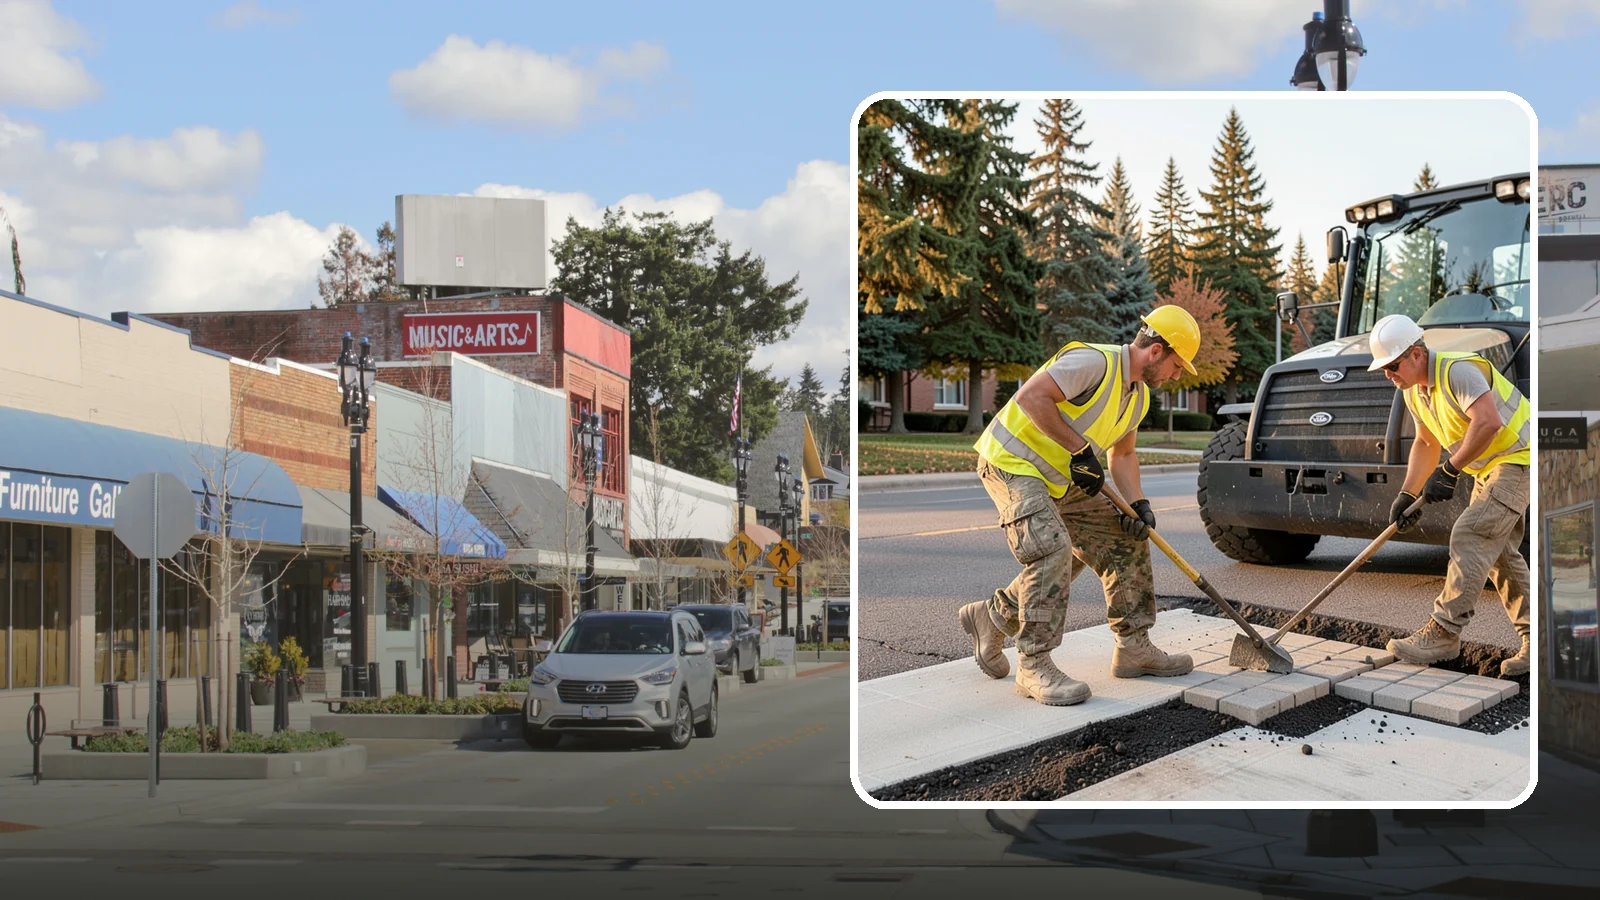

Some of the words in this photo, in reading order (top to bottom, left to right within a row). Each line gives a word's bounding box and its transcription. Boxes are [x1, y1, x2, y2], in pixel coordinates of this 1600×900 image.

[0, 471, 79, 515] Furniture
[89, 482, 121, 518] Gal
[453, 563, 480, 574] SUSHI
